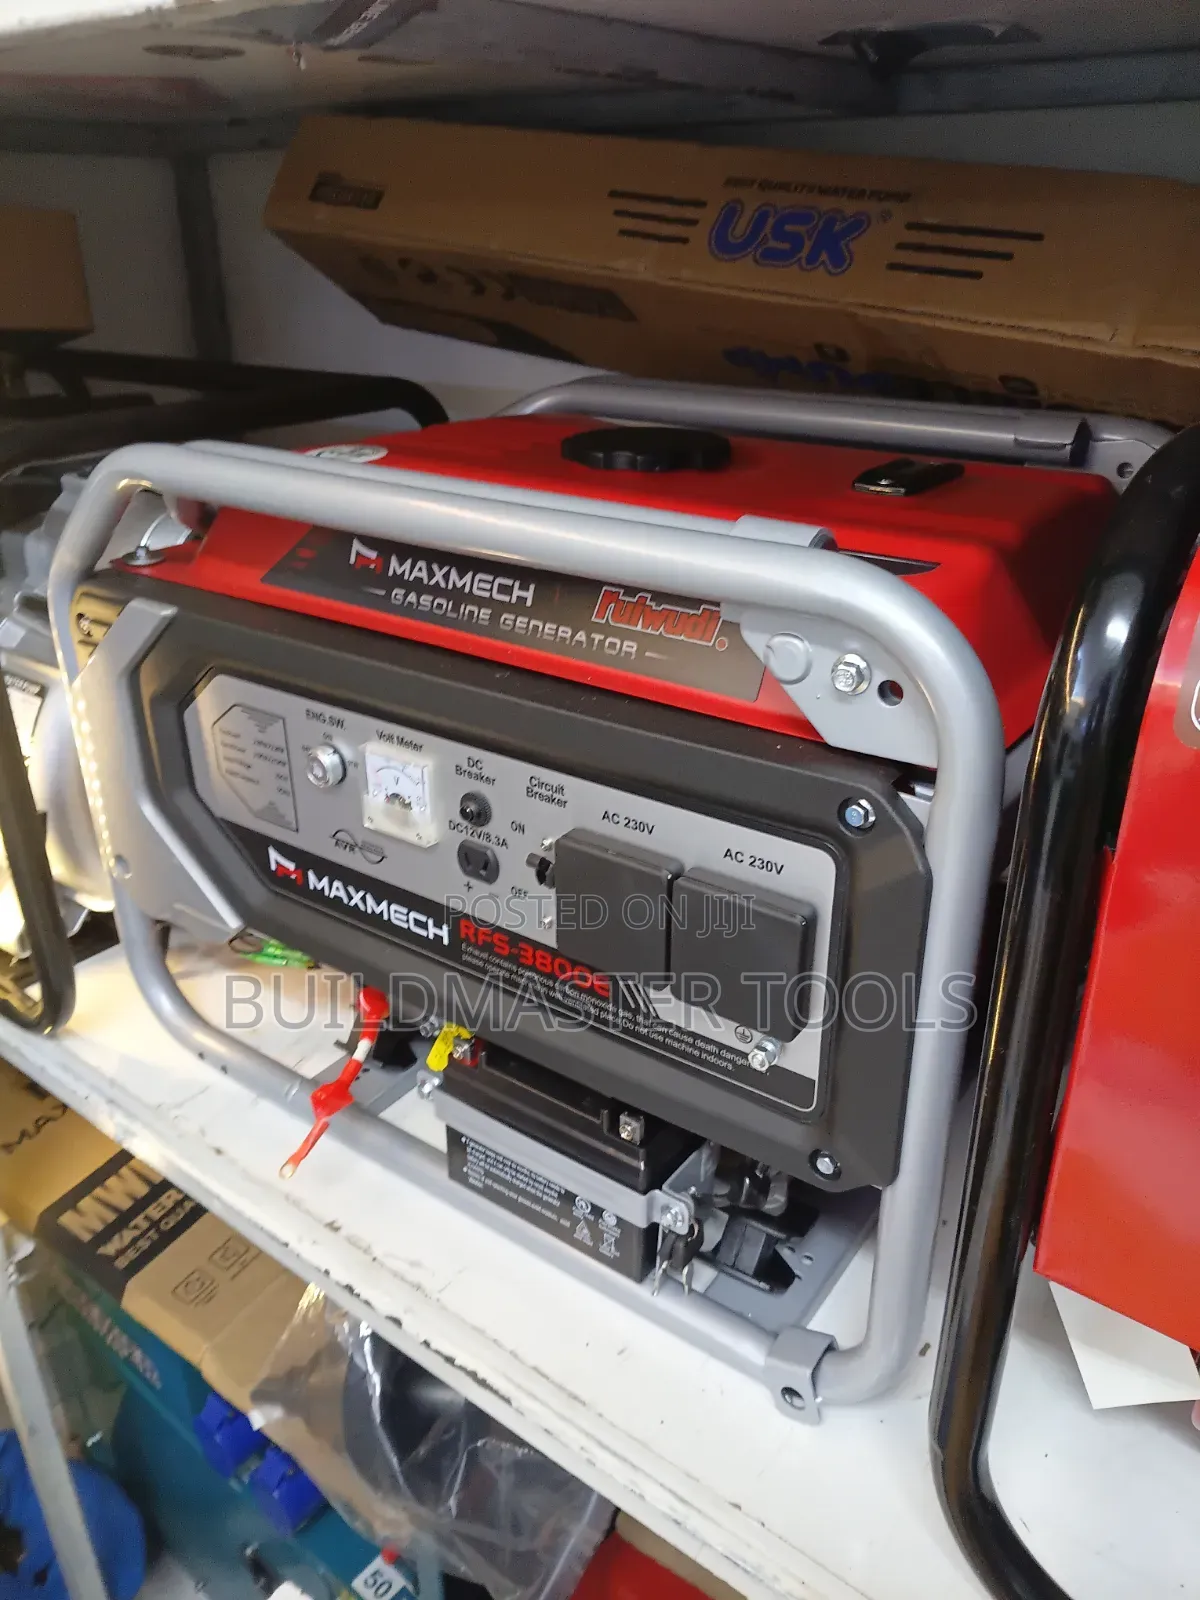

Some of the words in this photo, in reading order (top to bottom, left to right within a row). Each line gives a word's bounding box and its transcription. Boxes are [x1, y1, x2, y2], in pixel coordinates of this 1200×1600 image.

[708, 198, 871, 276] USK
[387, 556, 536, 608] MAXMECH
[390, 586, 493, 626] GASOLINE
[499, 611, 638, 660] GENERATOR
[397, 734, 425, 753] Meter
[455, 764, 497, 786] Breaker
[467, 756, 484, 771] DC
[526, 786, 569, 809] Breaker
[529, 775, 566, 797] Circuit
[510, 820, 526, 836] ON
[601, 810, 620, 825] AC
[623, 818, 656, 836] 230V
[723, 848, 745, 864] AC
[748, 855, 785, 876] 230V
[307, 868, 450, 946] MAXMECH
[459, 918, 612, 998] RFS-3800E
[665, 1035, 700, 1057] machine
[668, 1027, 694, 1044] cause
[694, 1036, 720, 1055] death
[97, 1188, 185, 1256] WATER
[363, 1569, 393, 1599] 50
